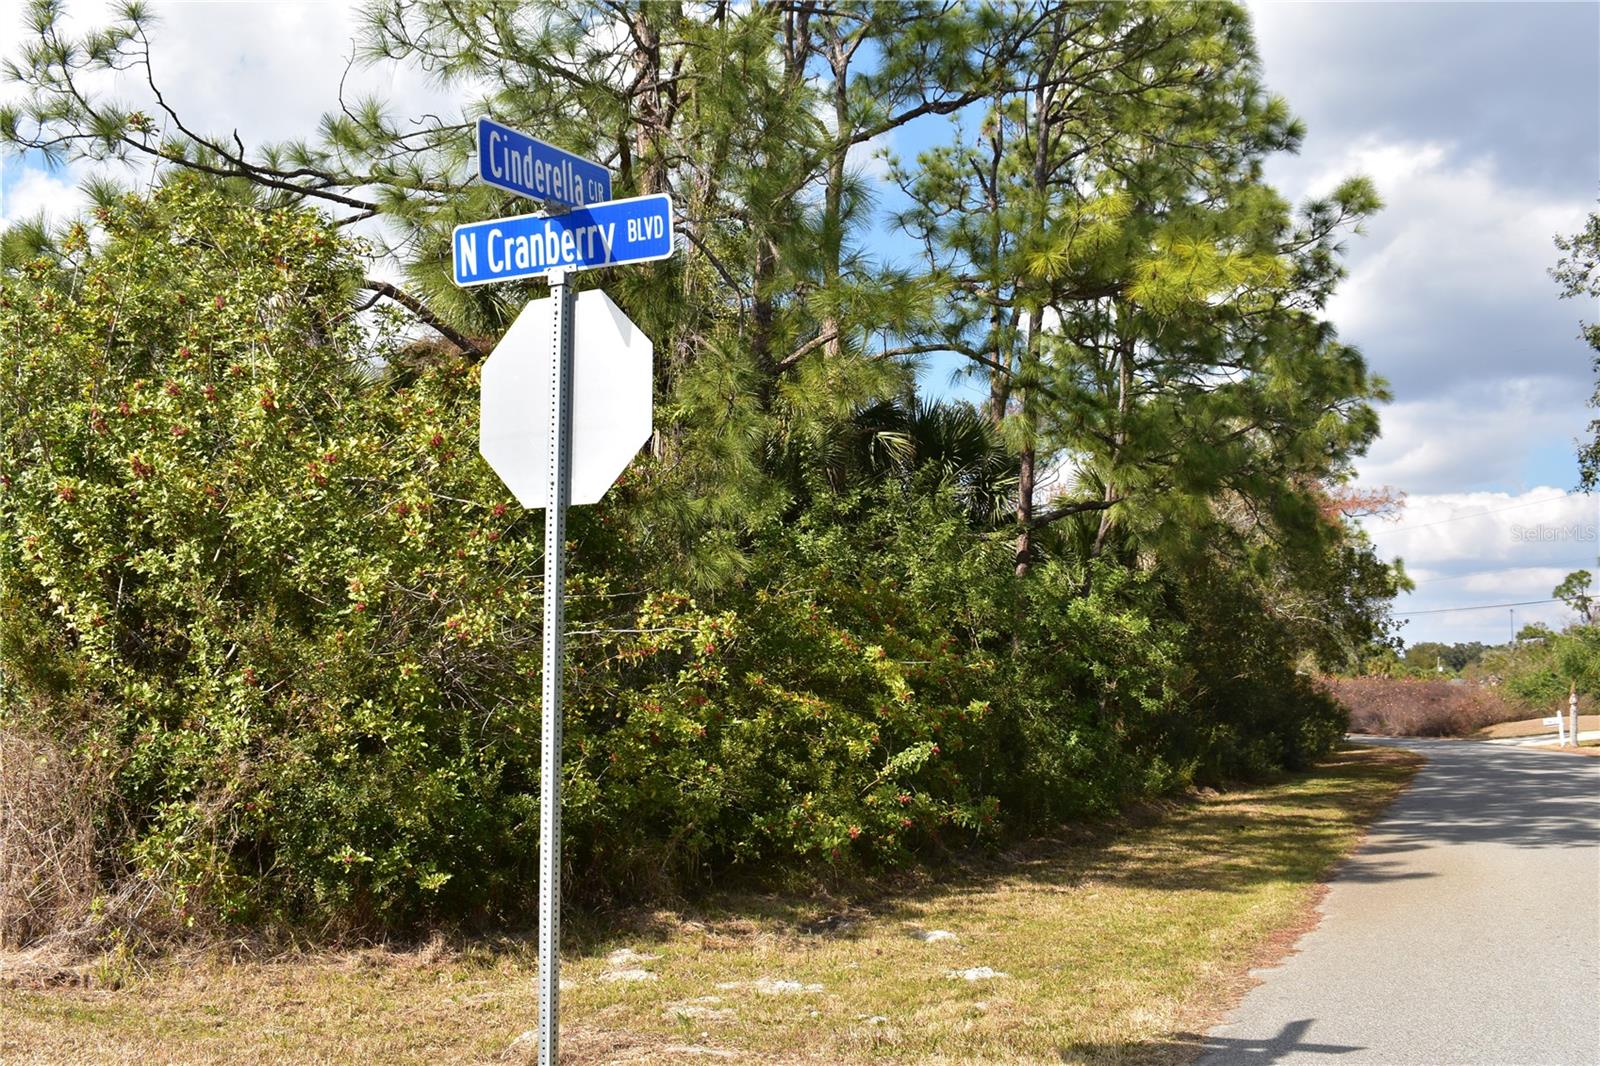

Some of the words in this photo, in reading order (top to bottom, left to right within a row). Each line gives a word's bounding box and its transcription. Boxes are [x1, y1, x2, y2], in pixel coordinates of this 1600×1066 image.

[489, 130, 585, 208] Cinderella
[588, 180, 604, 203] CIR
[460, 232, 477, 277] N
[487, 221, 615, 273] Cranberry
[627, 215, 664, 243] BLVD
